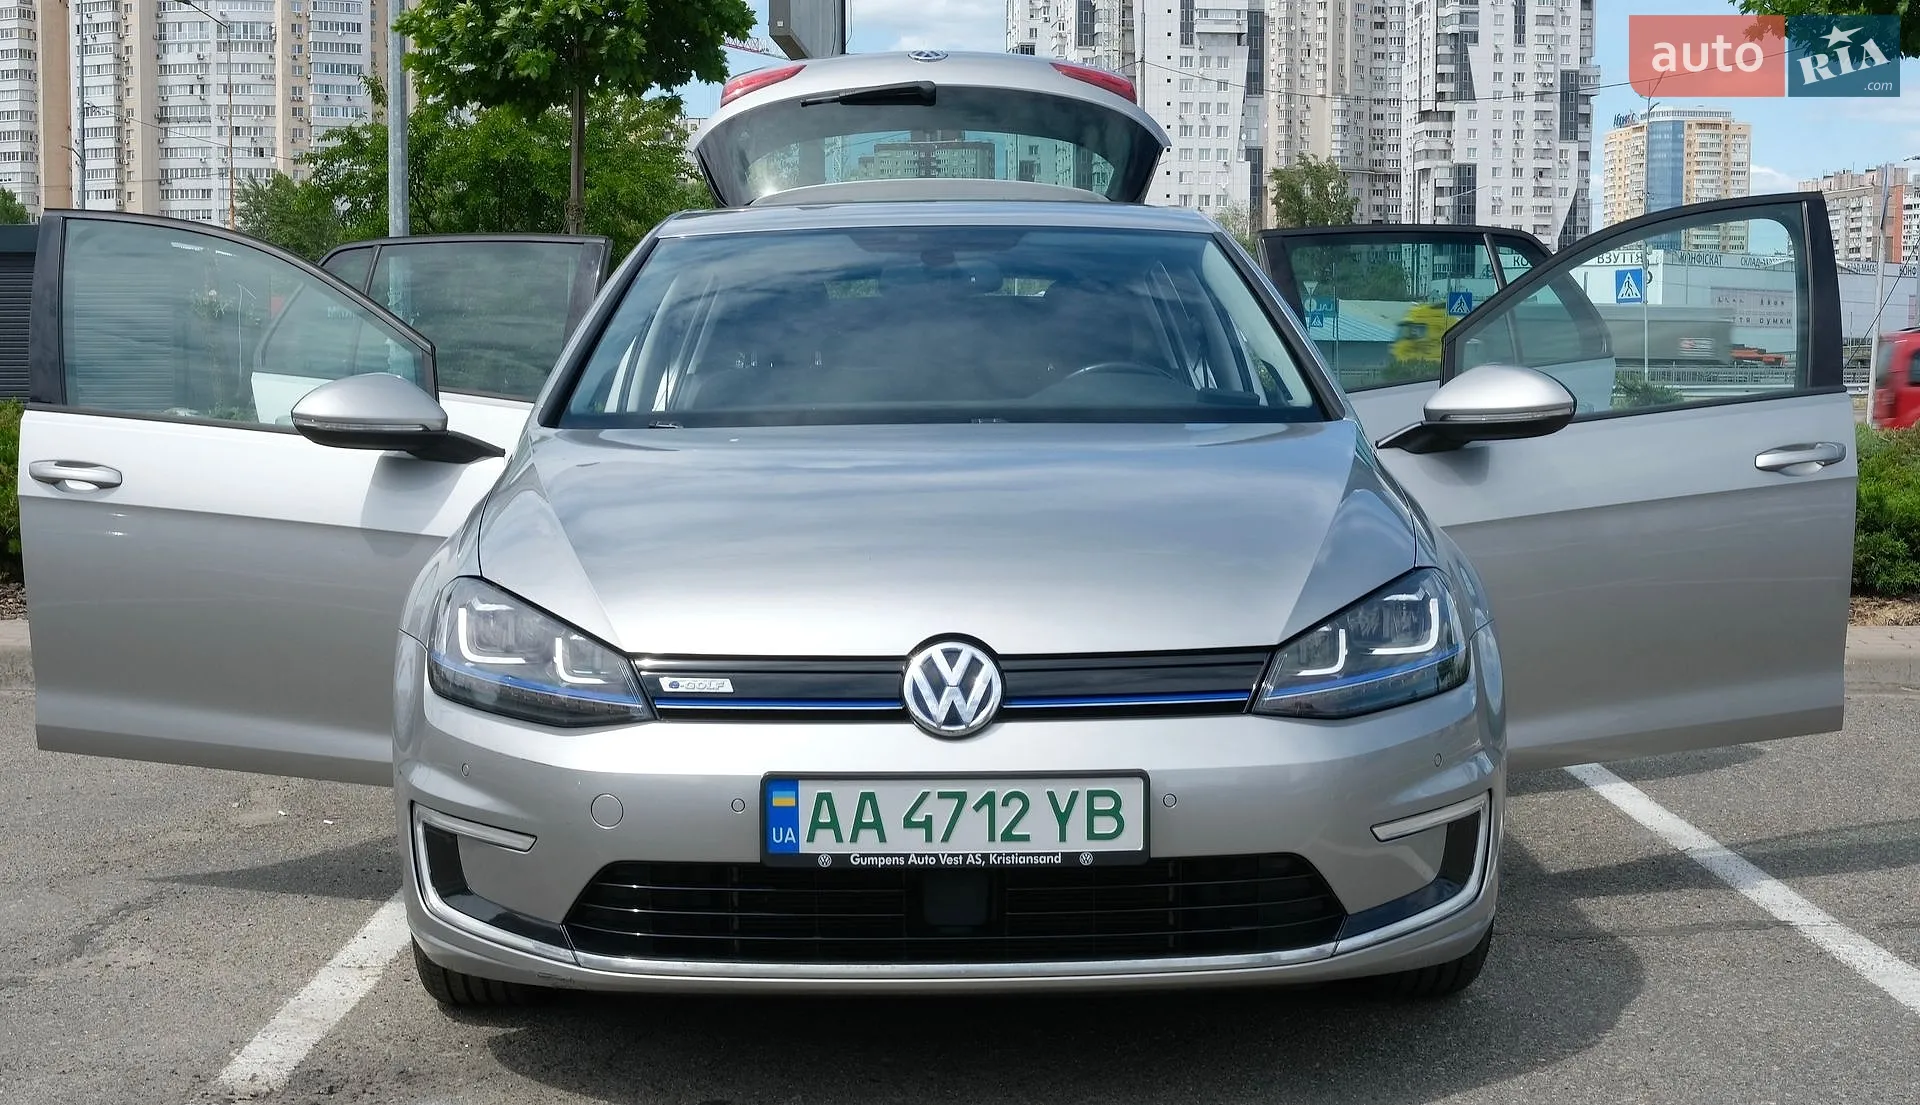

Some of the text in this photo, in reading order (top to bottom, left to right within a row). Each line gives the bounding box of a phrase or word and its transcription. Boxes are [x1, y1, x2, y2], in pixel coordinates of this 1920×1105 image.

[1680, 252, 1723, 266] КОНФІСКАТ
[805, 788, 1125, 844] AA 4712 YB
[772, 827, 796, 844] UA
[849, 853, 905, 868] Gumpens
[907, 853, 937, 865] Auto
[938, 853, 963, 865] Vest
[965, 853, 986, 867] AS,
[989, 852, 1062, 865] Kristiansand
